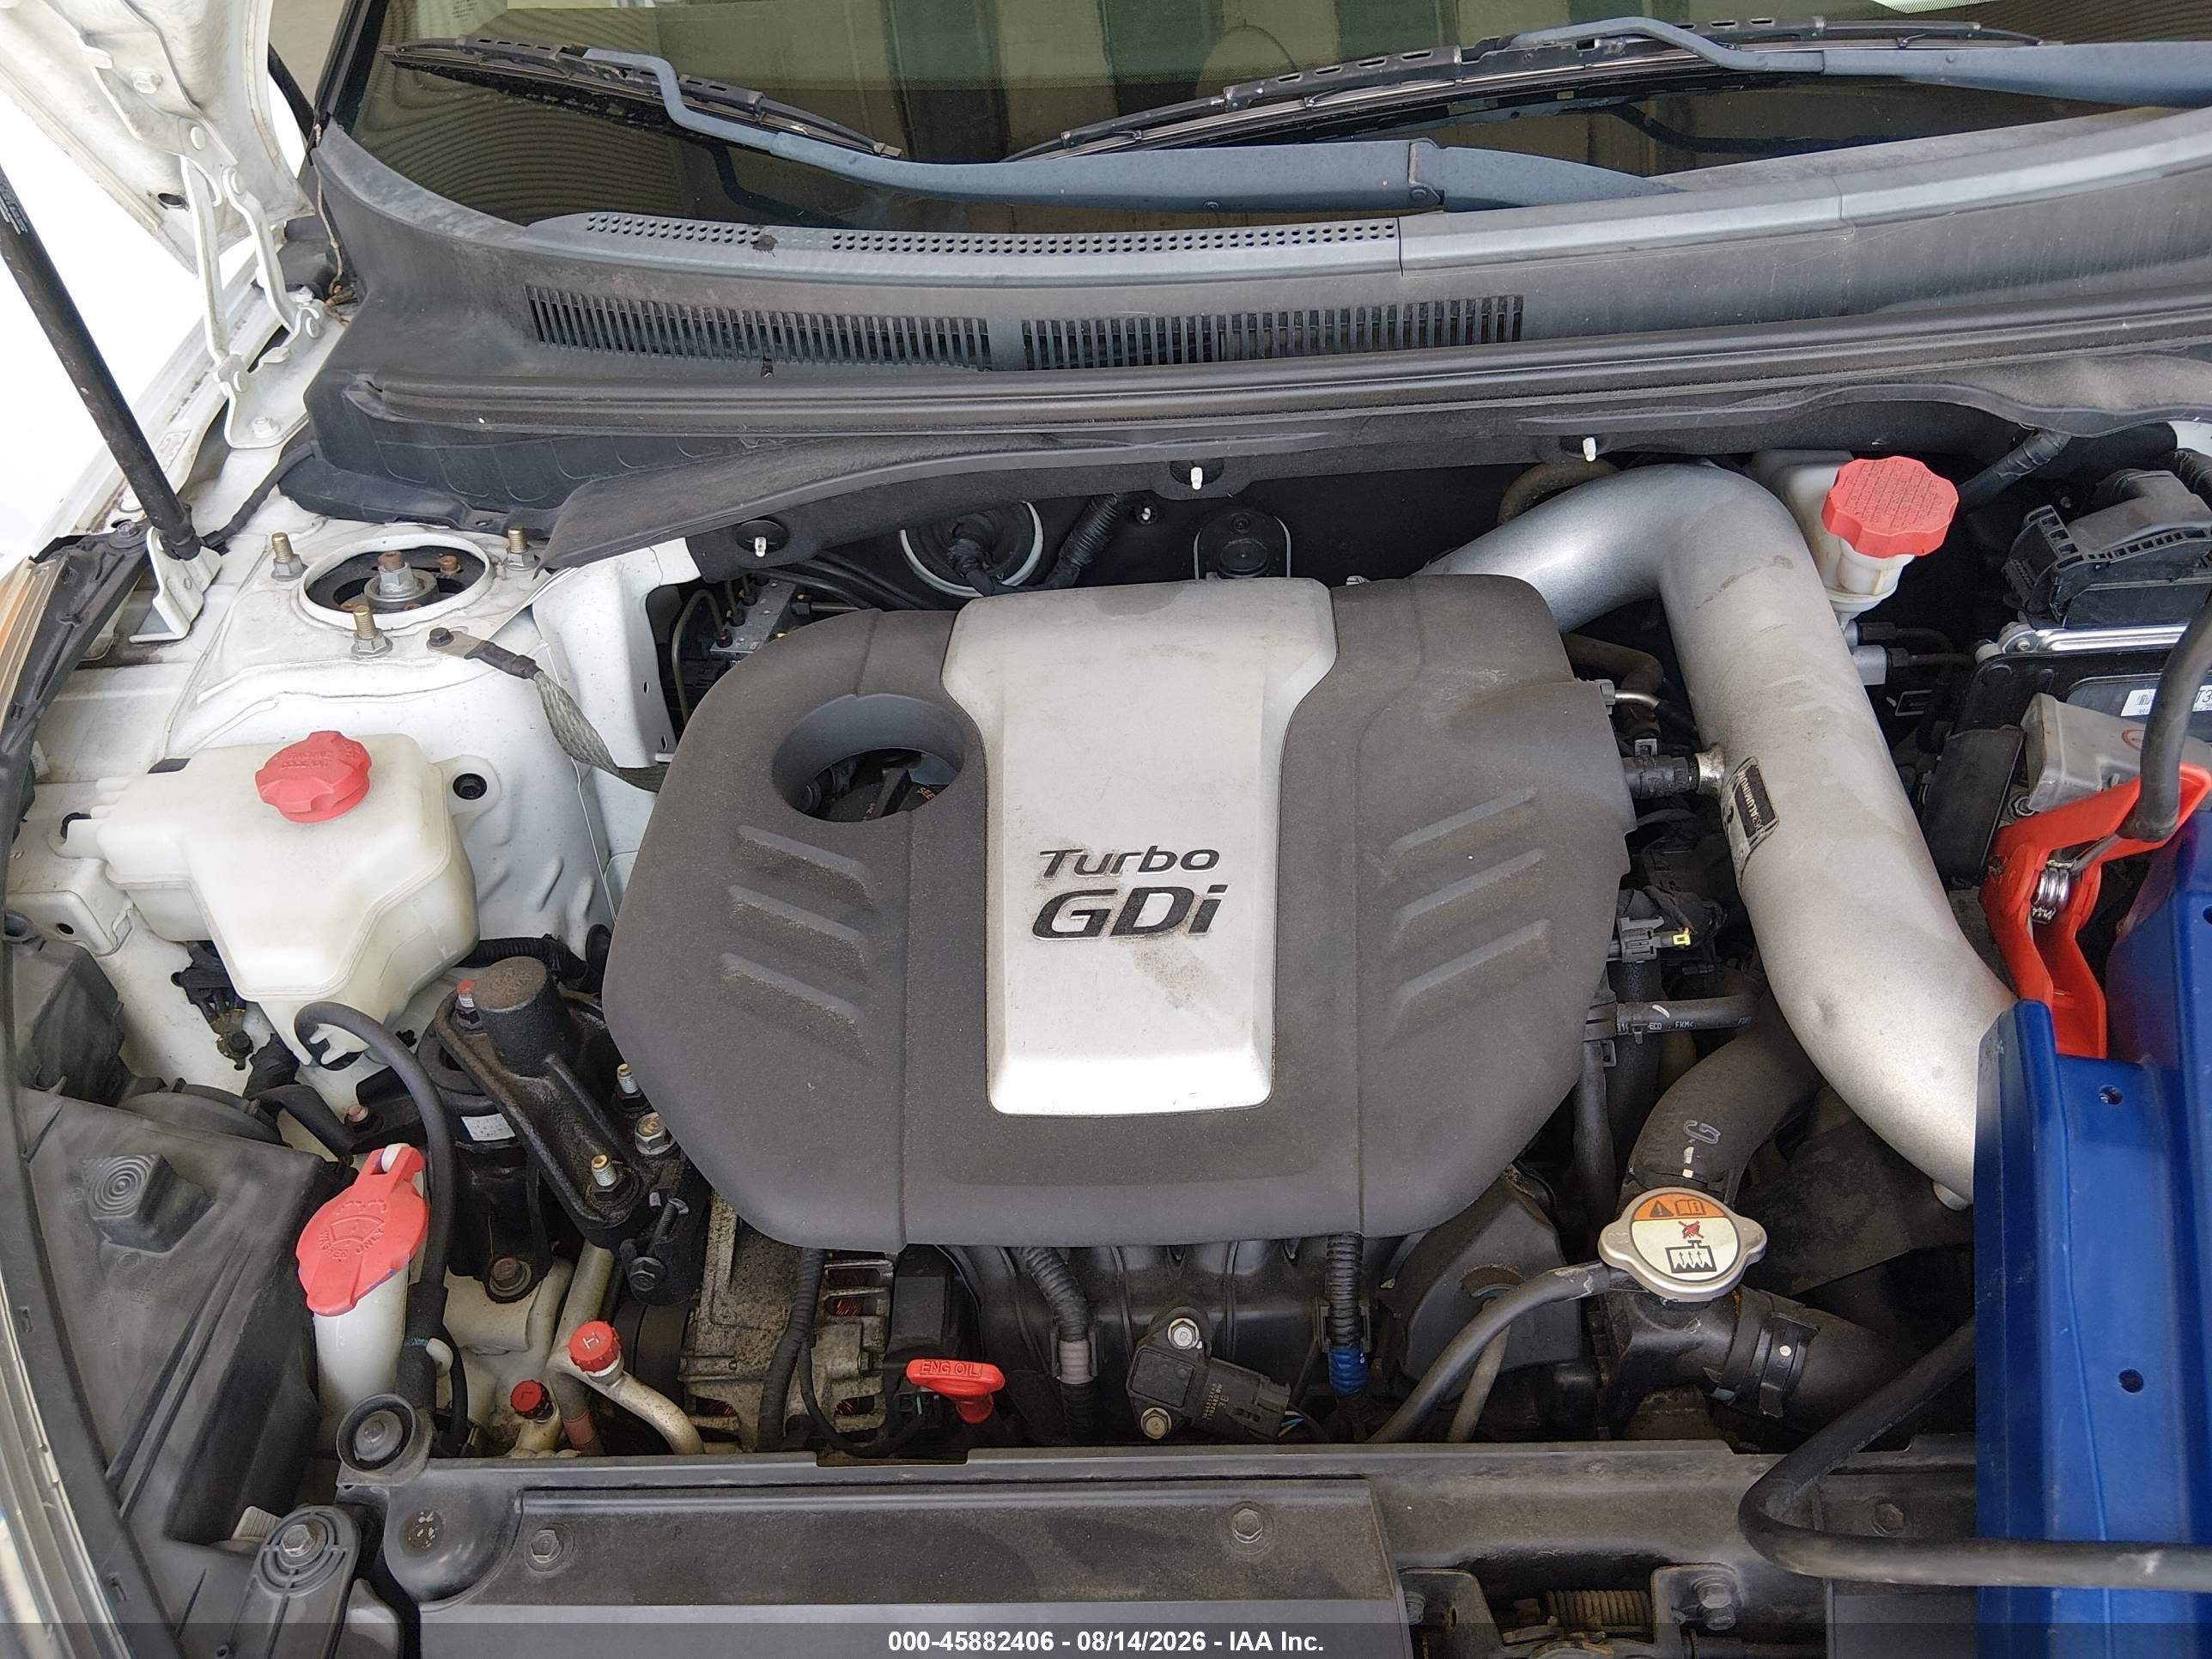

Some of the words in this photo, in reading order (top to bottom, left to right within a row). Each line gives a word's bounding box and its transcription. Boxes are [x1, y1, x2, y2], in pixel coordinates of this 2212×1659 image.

[1039, 845, 1222, 880] Turbo
[1031, 884, 1230, 941] GDi
[921, 1359, 951, 1376] ENG
[954, 1362, 981, 1377] OIL
